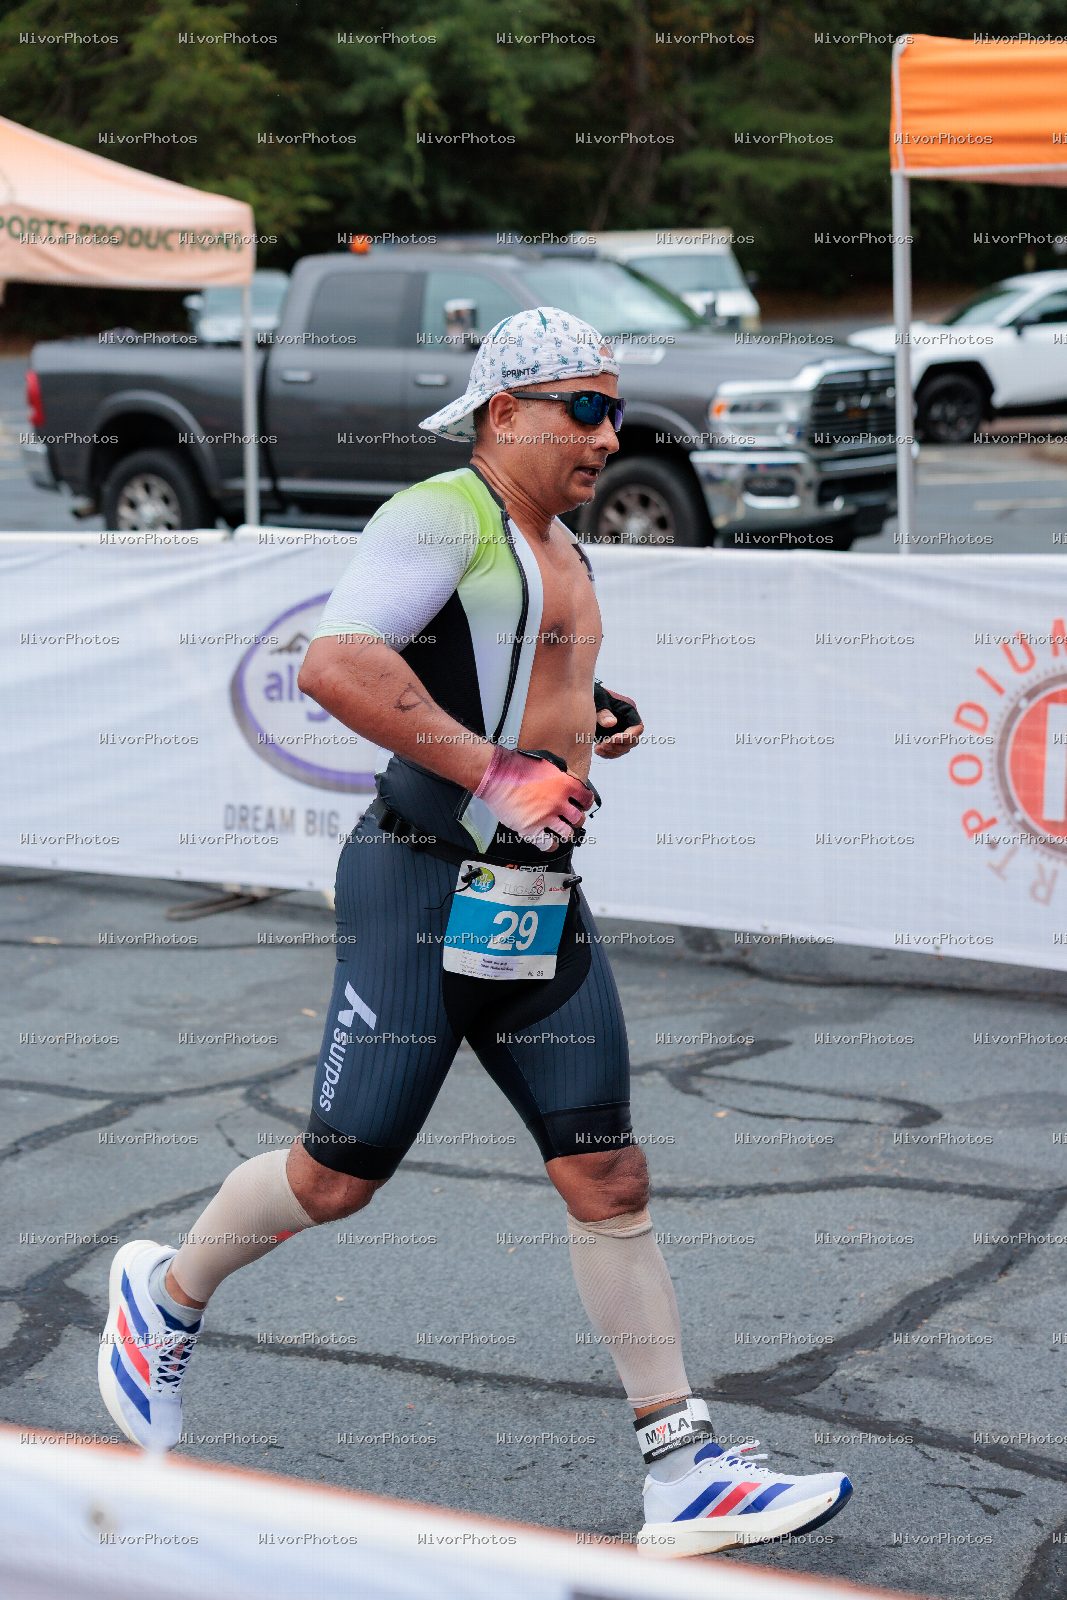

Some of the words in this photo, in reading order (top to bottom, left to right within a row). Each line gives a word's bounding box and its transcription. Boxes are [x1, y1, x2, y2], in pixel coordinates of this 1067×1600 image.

[501, 368, 537, 378] SPRINTS
[223, 804, 296, 835] DREAM
[306, 808, 340, 838] BIG
[487, 910, 539, 951] 29
